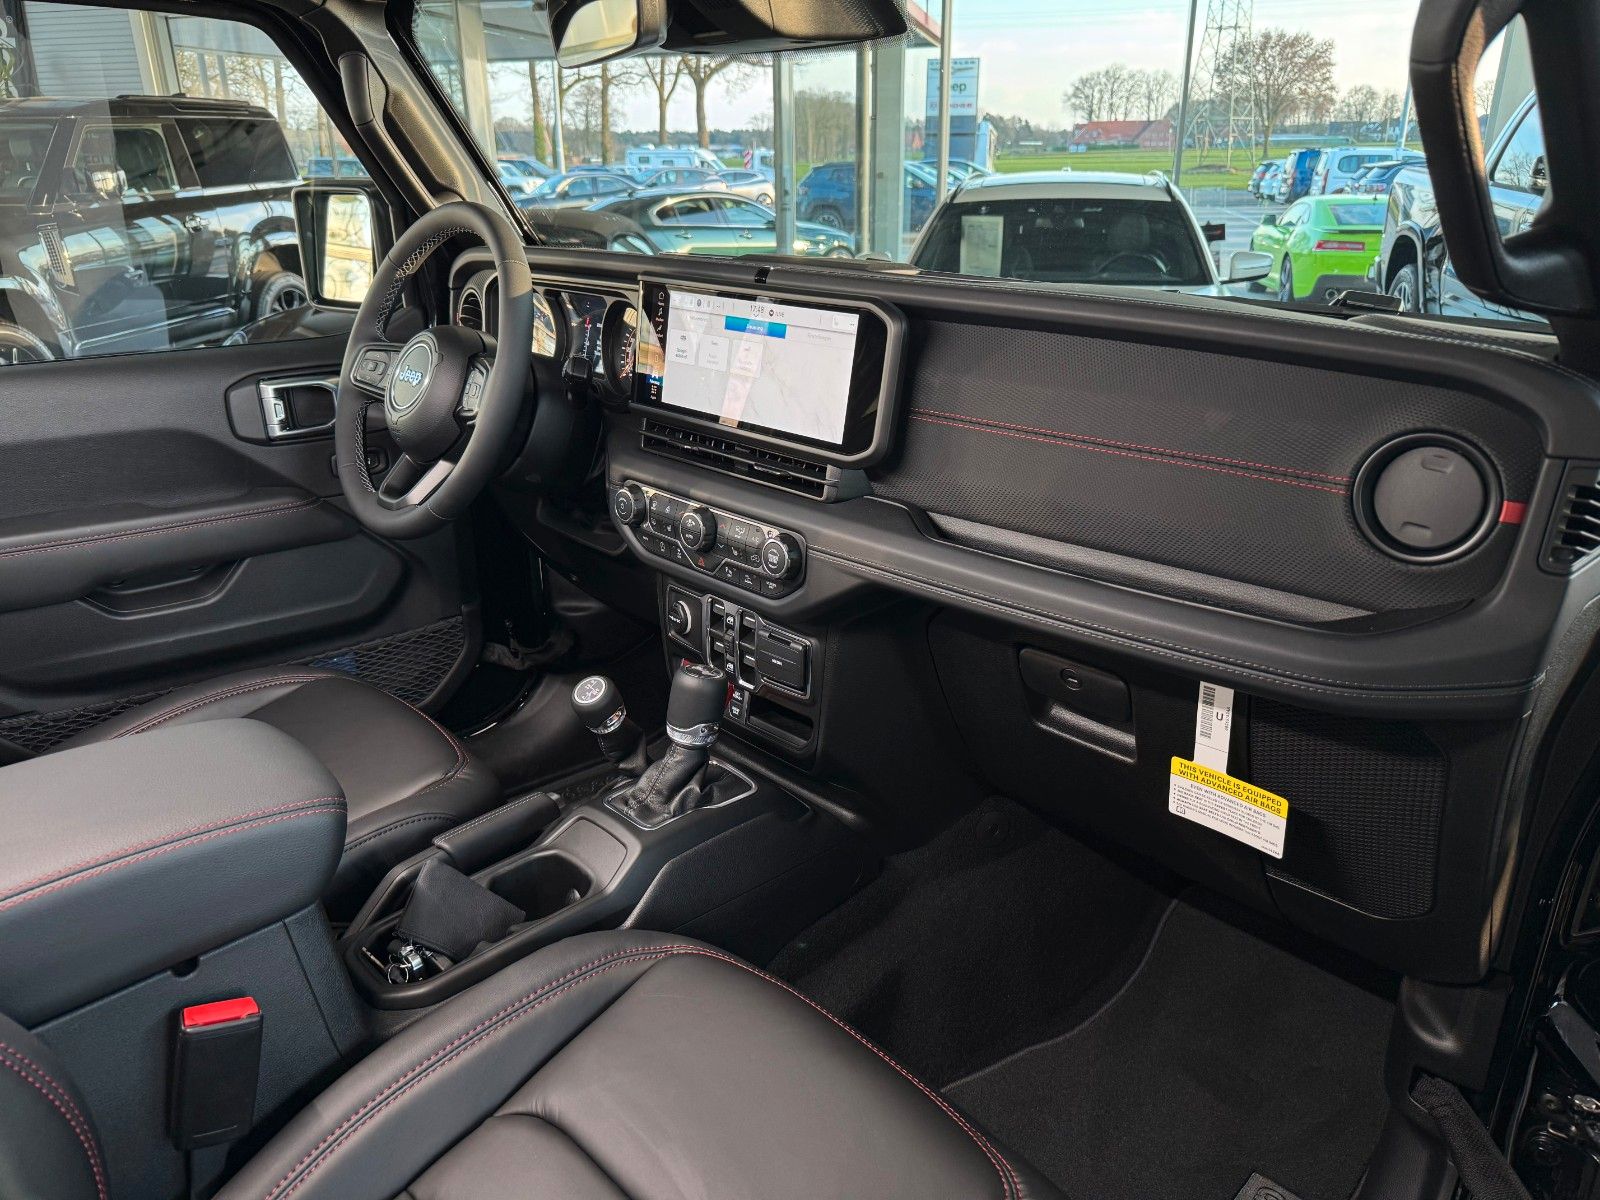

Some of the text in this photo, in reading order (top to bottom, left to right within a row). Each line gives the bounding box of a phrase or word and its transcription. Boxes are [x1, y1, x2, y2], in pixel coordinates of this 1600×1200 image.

[398, 365, 423, 387] Jeep
[1216, 711, 1224, 721] U
[1179, 762, 1282, 807] THIS VEHICLE IS EQUIPPED
[1179, 768, 1282, 815] WITH ADVANCED AIR BAGS
